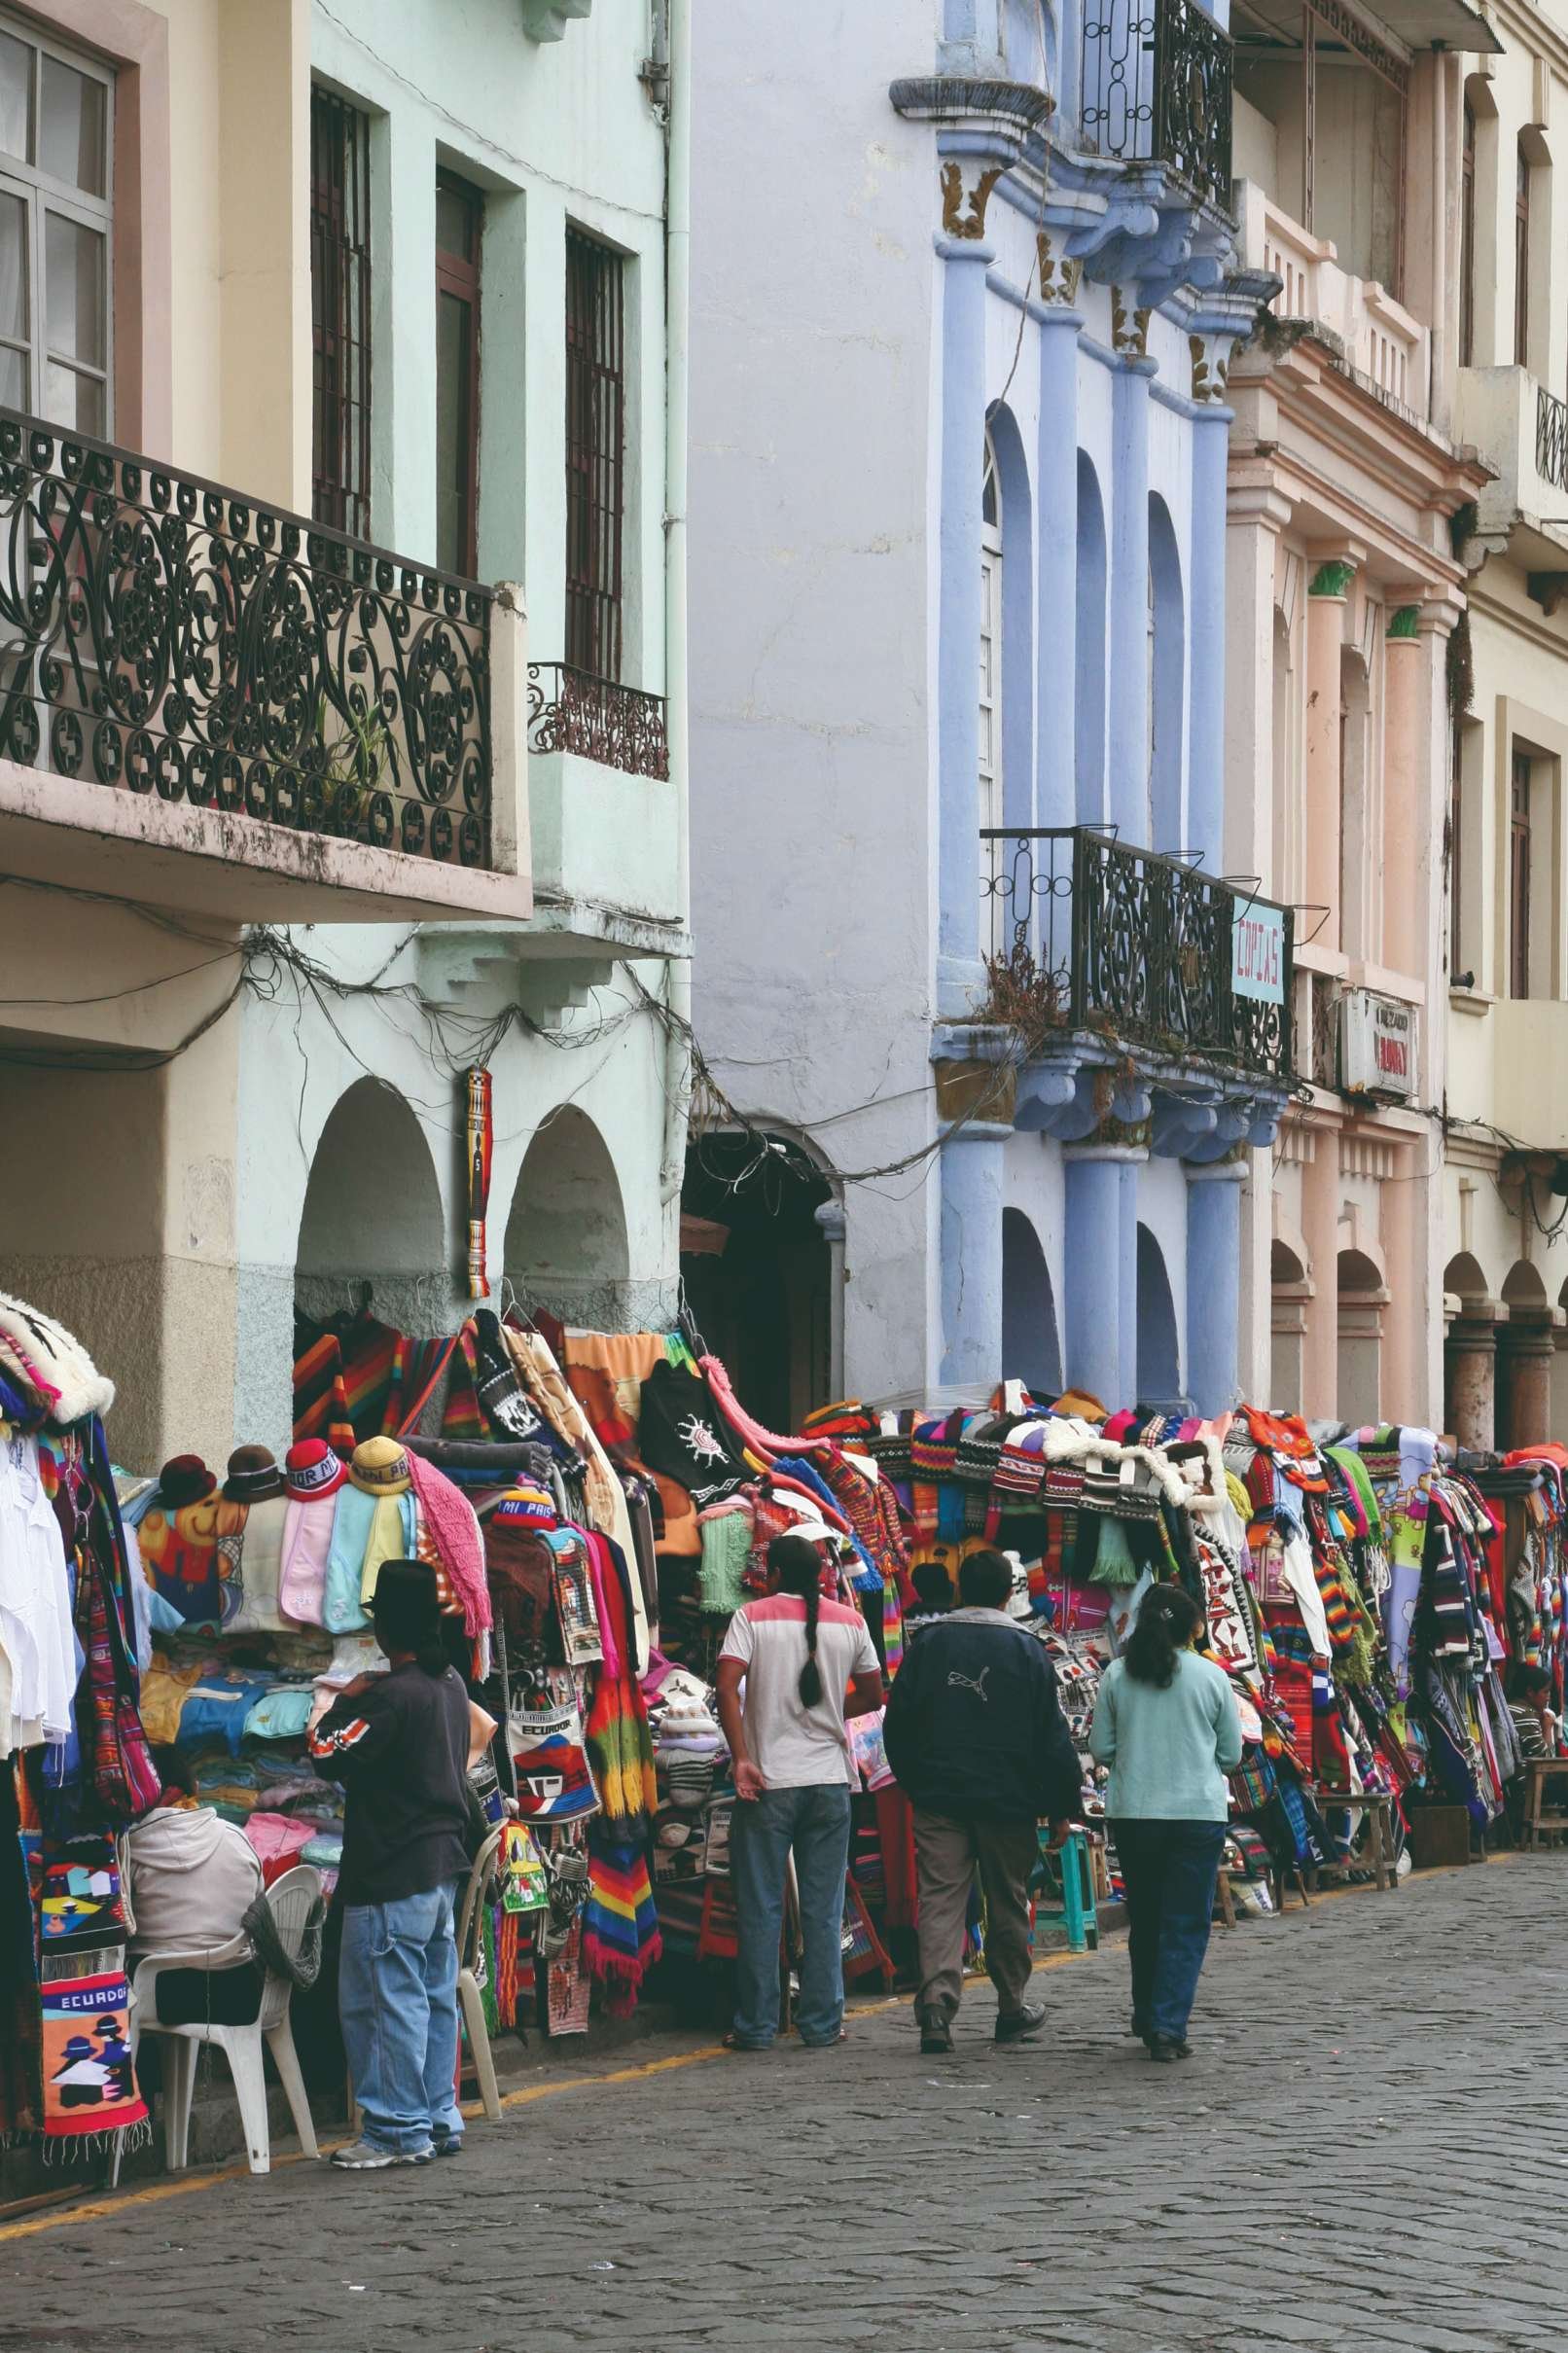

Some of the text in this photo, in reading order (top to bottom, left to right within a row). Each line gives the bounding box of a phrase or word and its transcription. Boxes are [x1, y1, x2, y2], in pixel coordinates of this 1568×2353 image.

[1237, 918, 1277, 985] COPIAS
[502, 1501, 520, 1515] MI
[521, 1719, 573, 1735] ECUADOR
